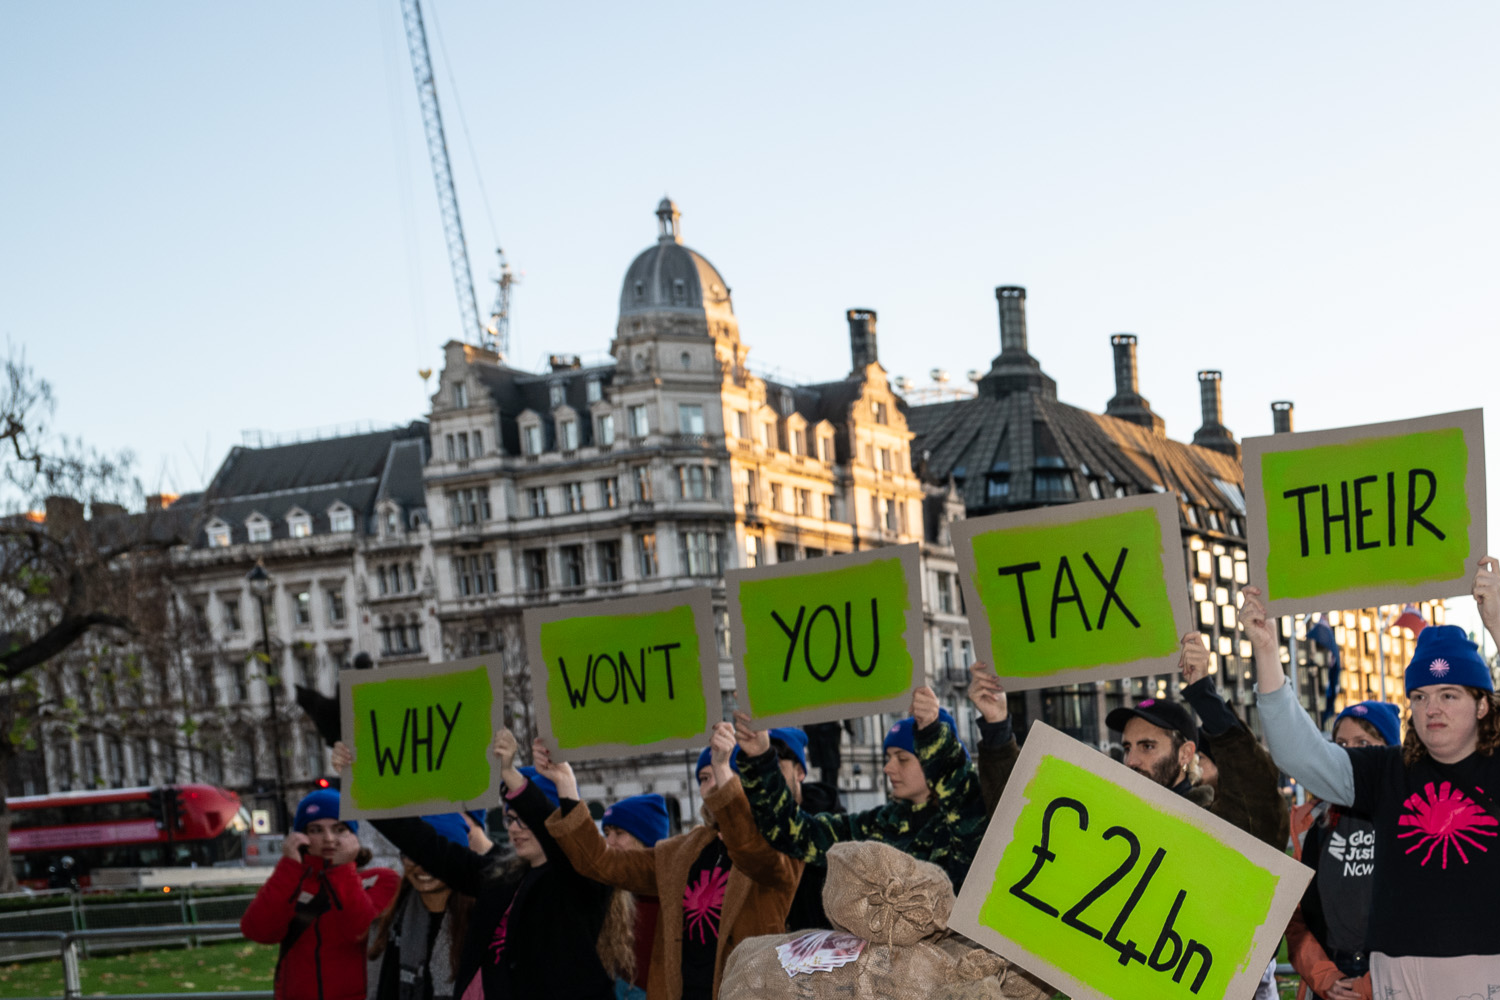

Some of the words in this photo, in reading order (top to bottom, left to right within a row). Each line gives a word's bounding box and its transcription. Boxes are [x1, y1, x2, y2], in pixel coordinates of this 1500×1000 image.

[1283, 468, 1447, 558] THEIR
[998, 547, 1141, 643] TAX
[558, 642, 681, 709] WON'T
[770, 598, 880, 682] YOU
[370, 701, 462, 776] WHY
[1349, 830, 1375, 846] Glo
[1009, 797, 1213, 994] £24bn
